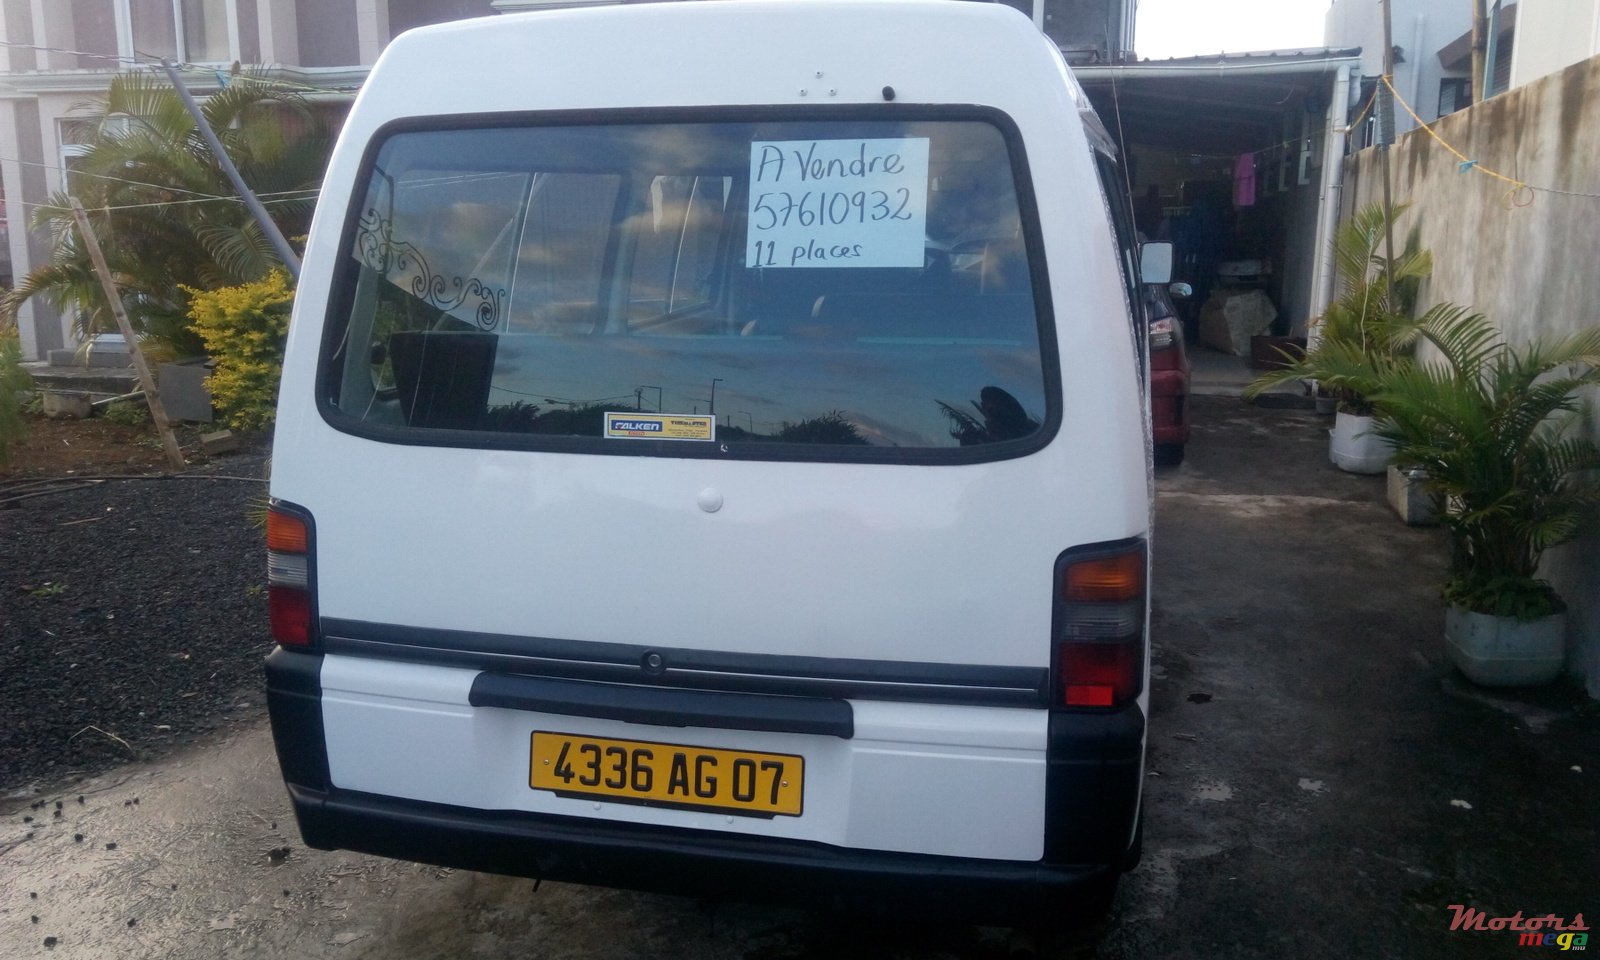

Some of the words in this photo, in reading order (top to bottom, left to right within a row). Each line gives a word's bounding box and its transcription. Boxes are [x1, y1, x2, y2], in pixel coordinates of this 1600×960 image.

[757, 145, 786, 182] A
[793, 142, 905, 182] Vendre
[753, 187, 913, 230] 57610932
[752, 240, 776, 268] 11
[791, 239, 863, 266] places
[614, 421, 660, 431] FALKEN
[553, 741, 654, 793] 4336
[667, 752, 718, 799] AG
[732, 758, 784, 805] 07
